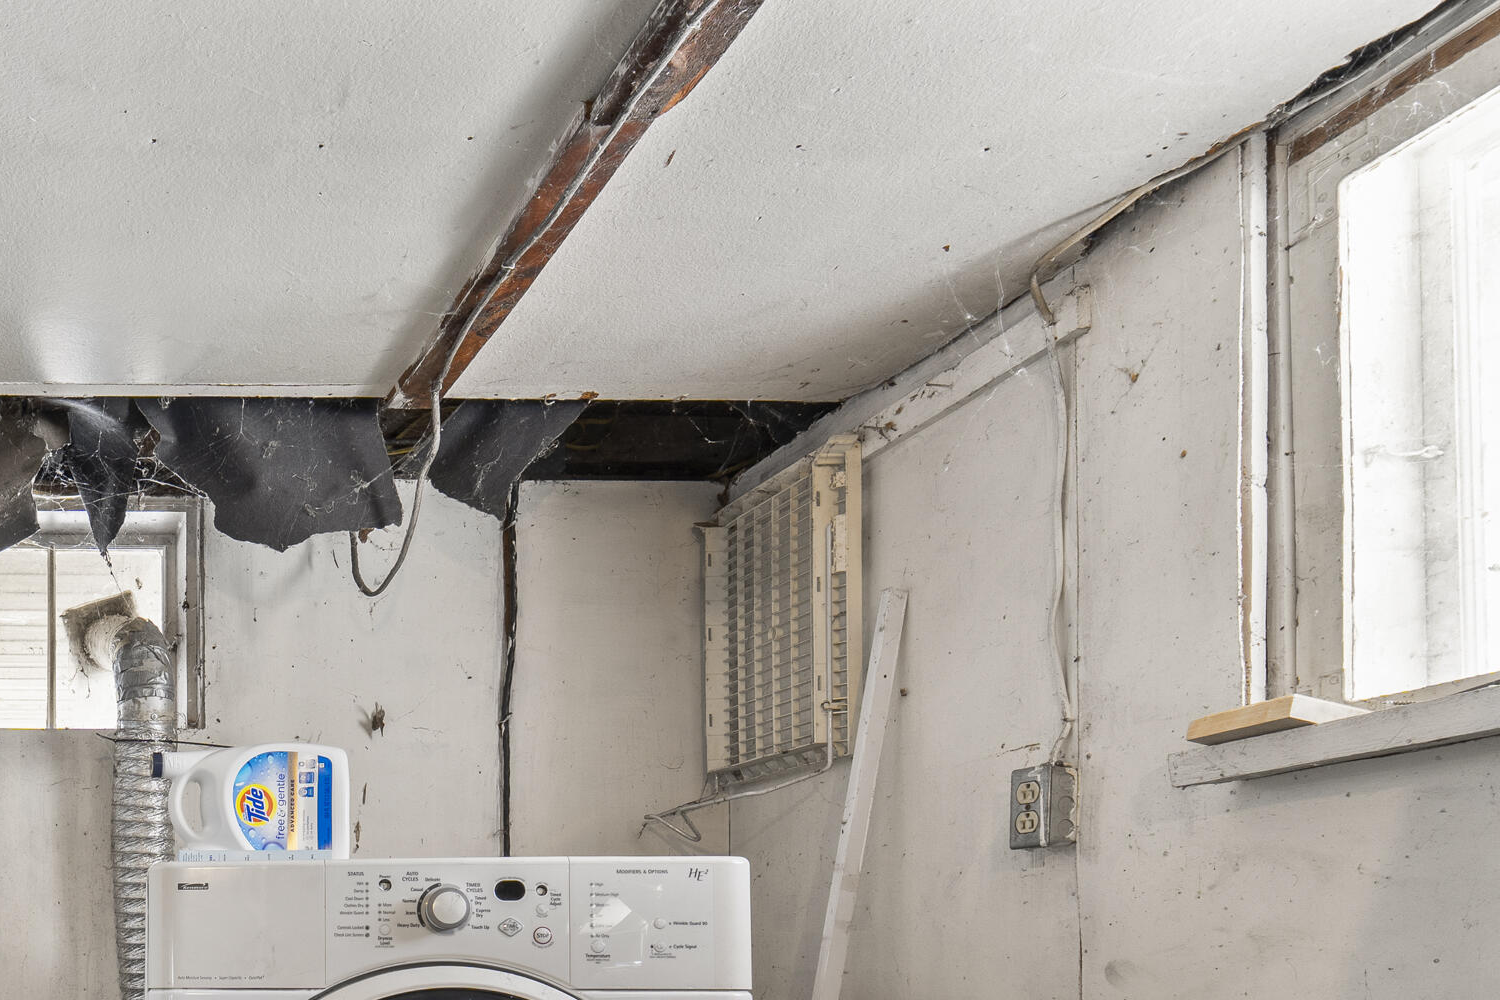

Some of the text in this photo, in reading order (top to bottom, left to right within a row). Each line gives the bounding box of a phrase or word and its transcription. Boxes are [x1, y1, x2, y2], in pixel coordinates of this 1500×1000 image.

[247, 787, 270, 823] Tide
[276, 773, 288, 807] gentle
[276, 820, 285, 840] free
